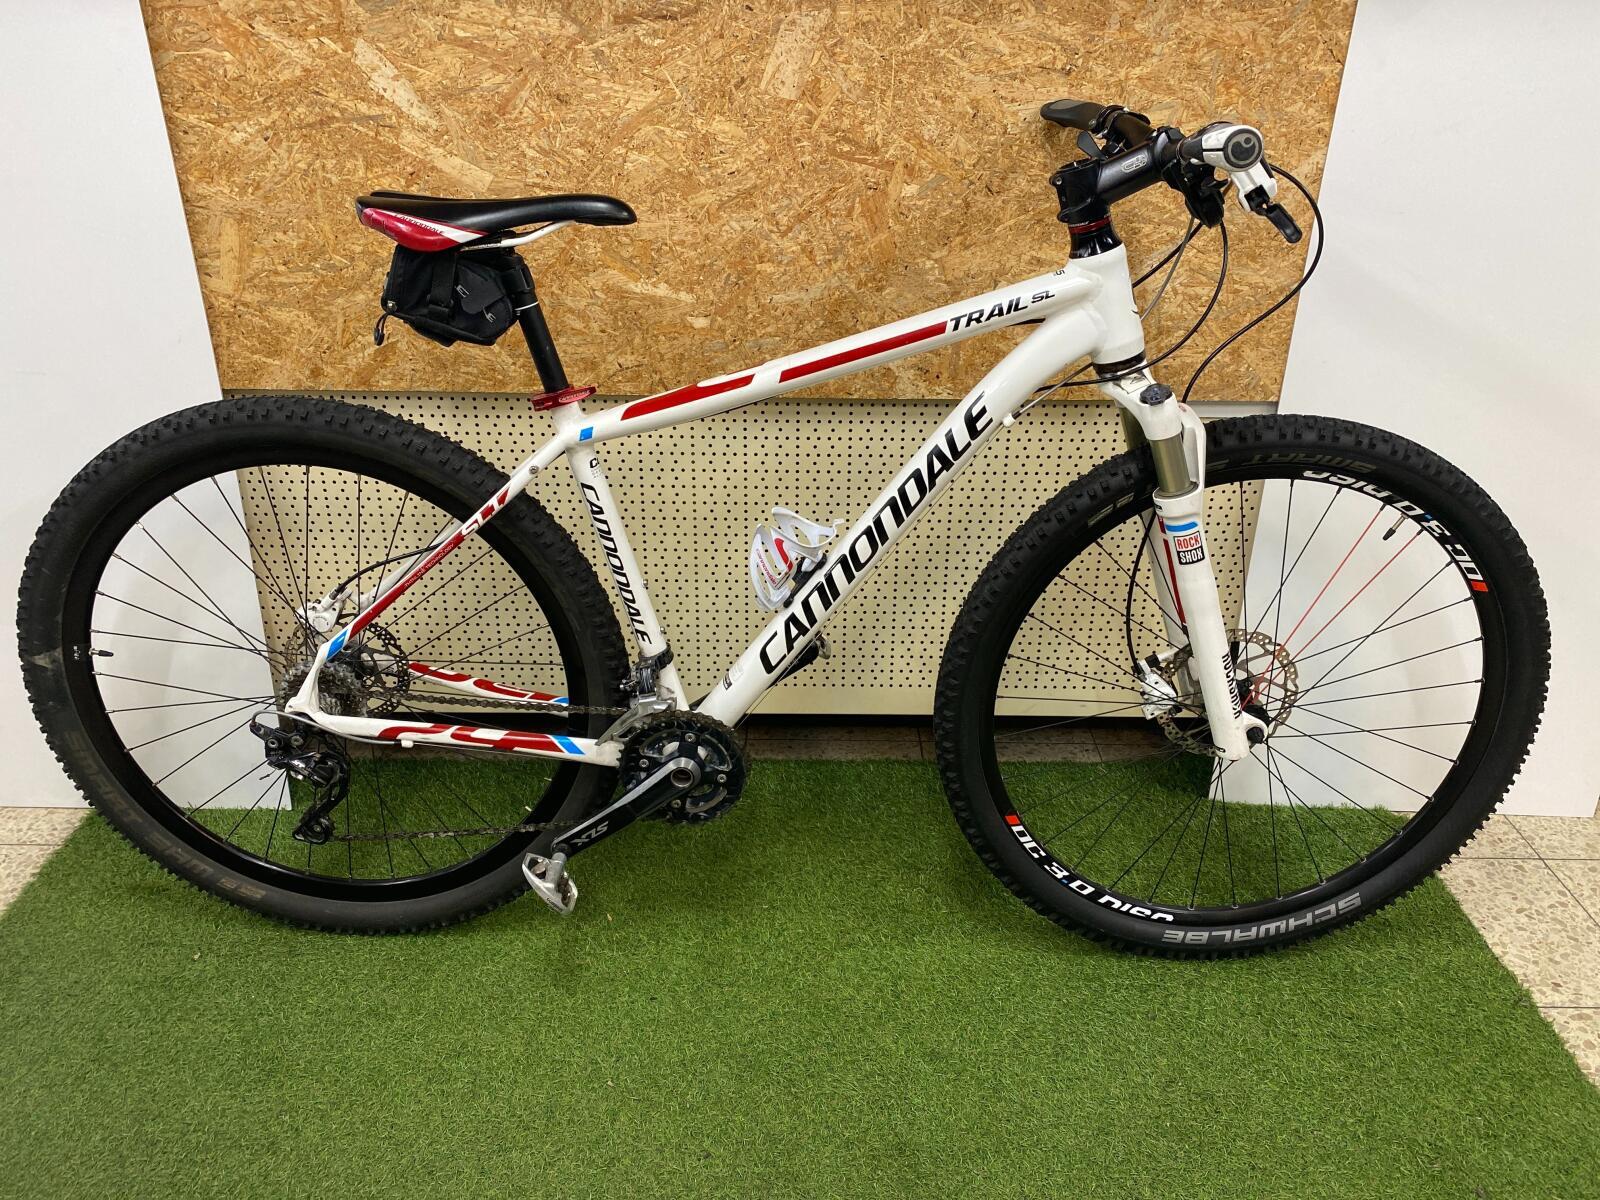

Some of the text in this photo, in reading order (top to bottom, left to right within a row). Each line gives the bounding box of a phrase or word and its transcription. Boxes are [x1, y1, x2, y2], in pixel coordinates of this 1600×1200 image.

[950, 290, 1055, 332] TRAIL SL
[1176, 536, 1200, 550] ROCK
[1180, 549, 1204, 563] SHOX
[1162, 892, 1362, 944] SCHWALBE
